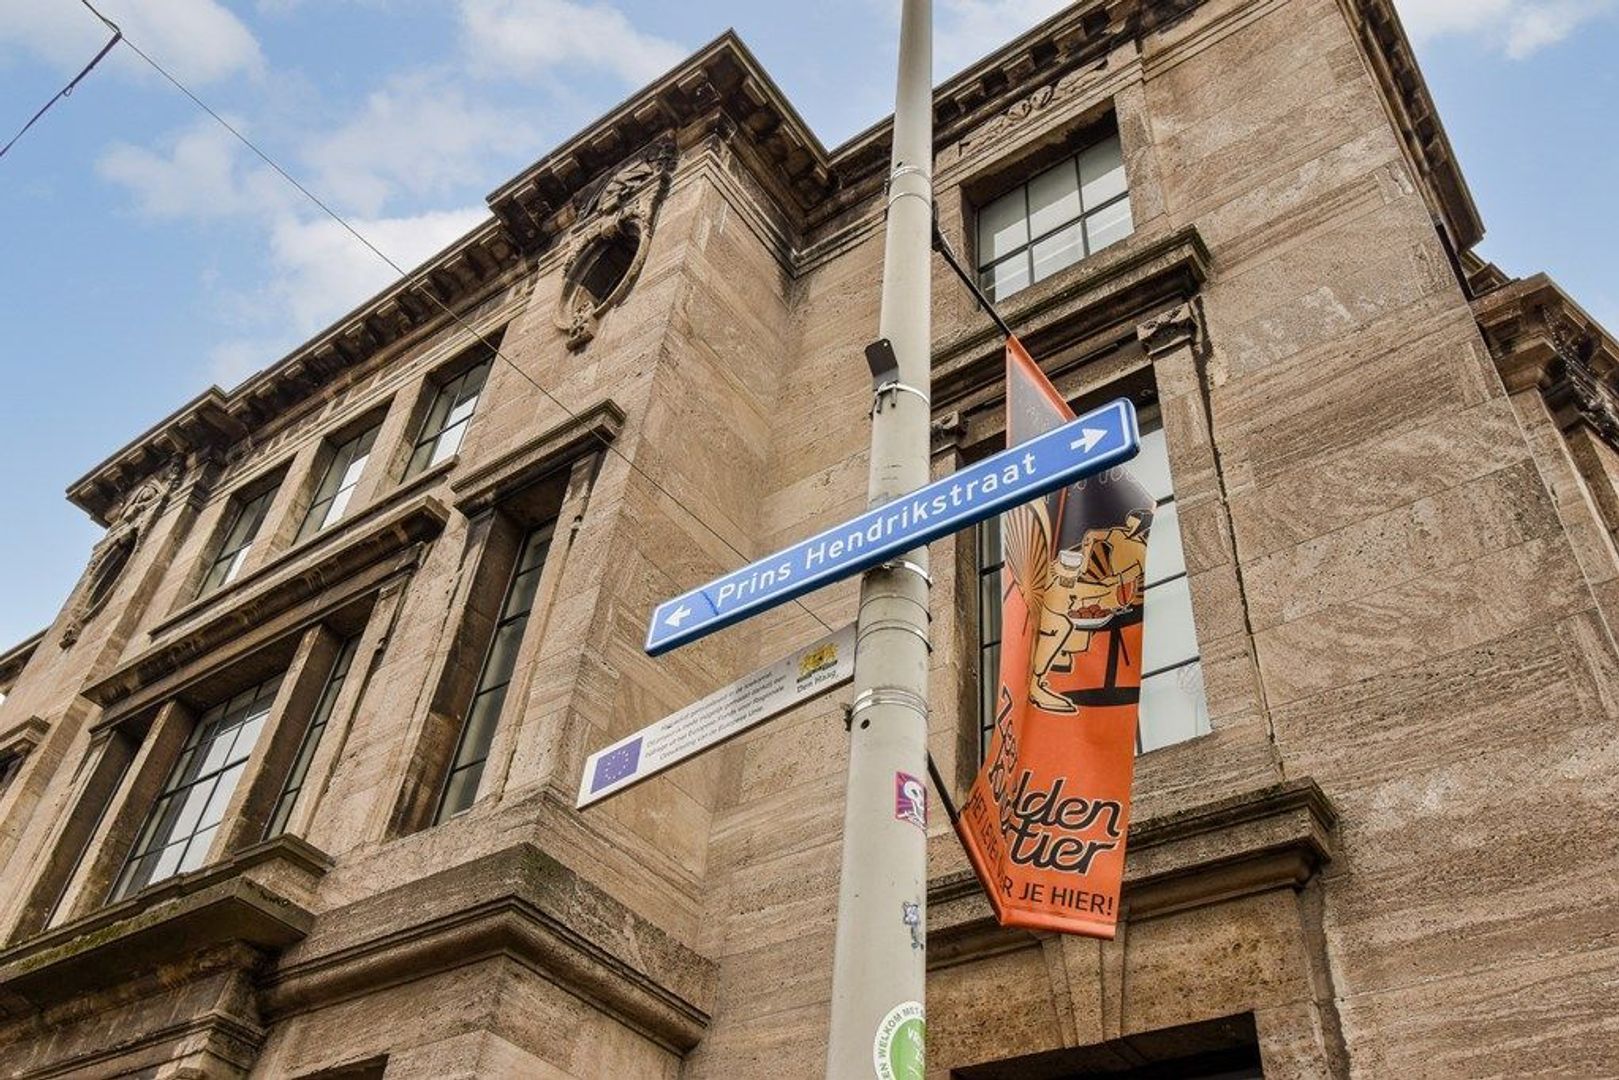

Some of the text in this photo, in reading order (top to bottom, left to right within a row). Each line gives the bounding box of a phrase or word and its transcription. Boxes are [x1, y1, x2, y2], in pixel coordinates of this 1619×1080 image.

[715, 451, 1038, 608] Prins Hendrikstraat
[797, 669, 836, 693] Den Haag
[1018, 882, 1045, 904] JE
[1050, 888, 1114, 916] HIER!
[877, 1013, 903, 1059] WELKOM
